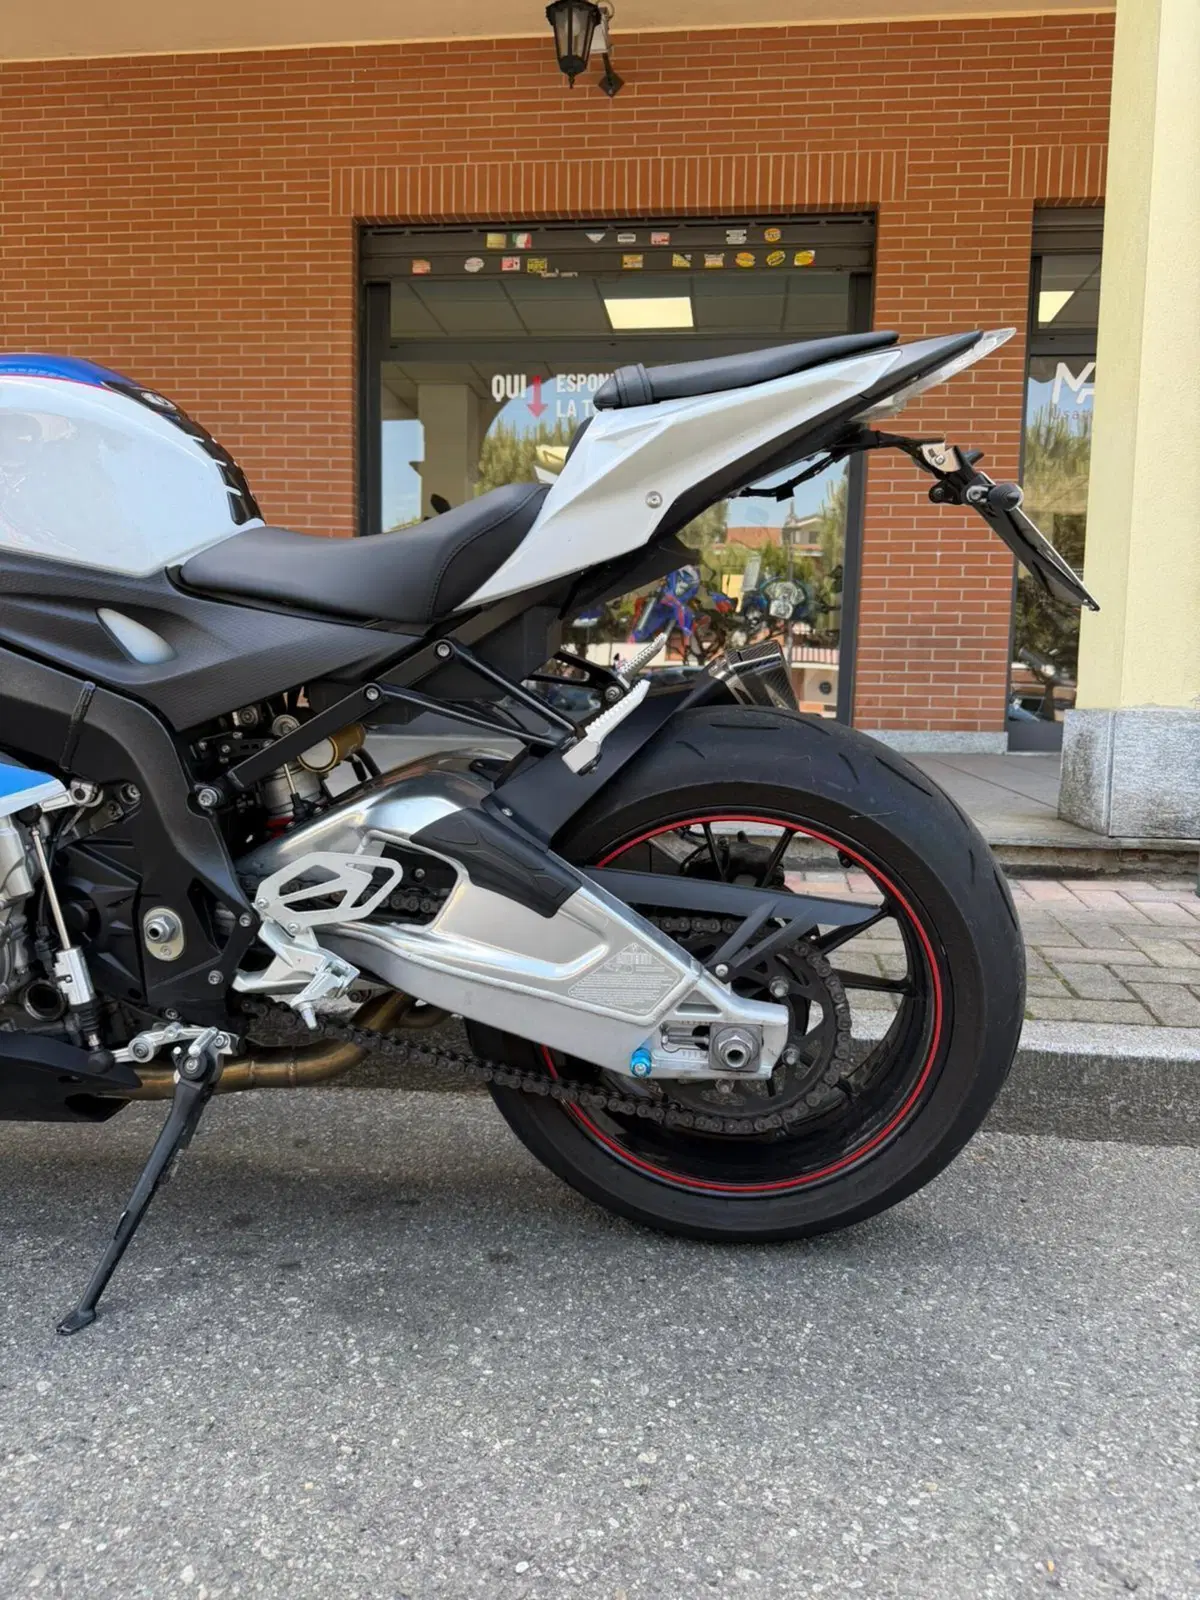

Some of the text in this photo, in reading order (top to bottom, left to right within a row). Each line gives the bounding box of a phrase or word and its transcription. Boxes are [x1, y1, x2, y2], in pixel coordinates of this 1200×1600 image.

[491, 374, 527, 402] QUI
[556, 373, 614, 393] ESPON
[556, 399, 577, 418] LA
